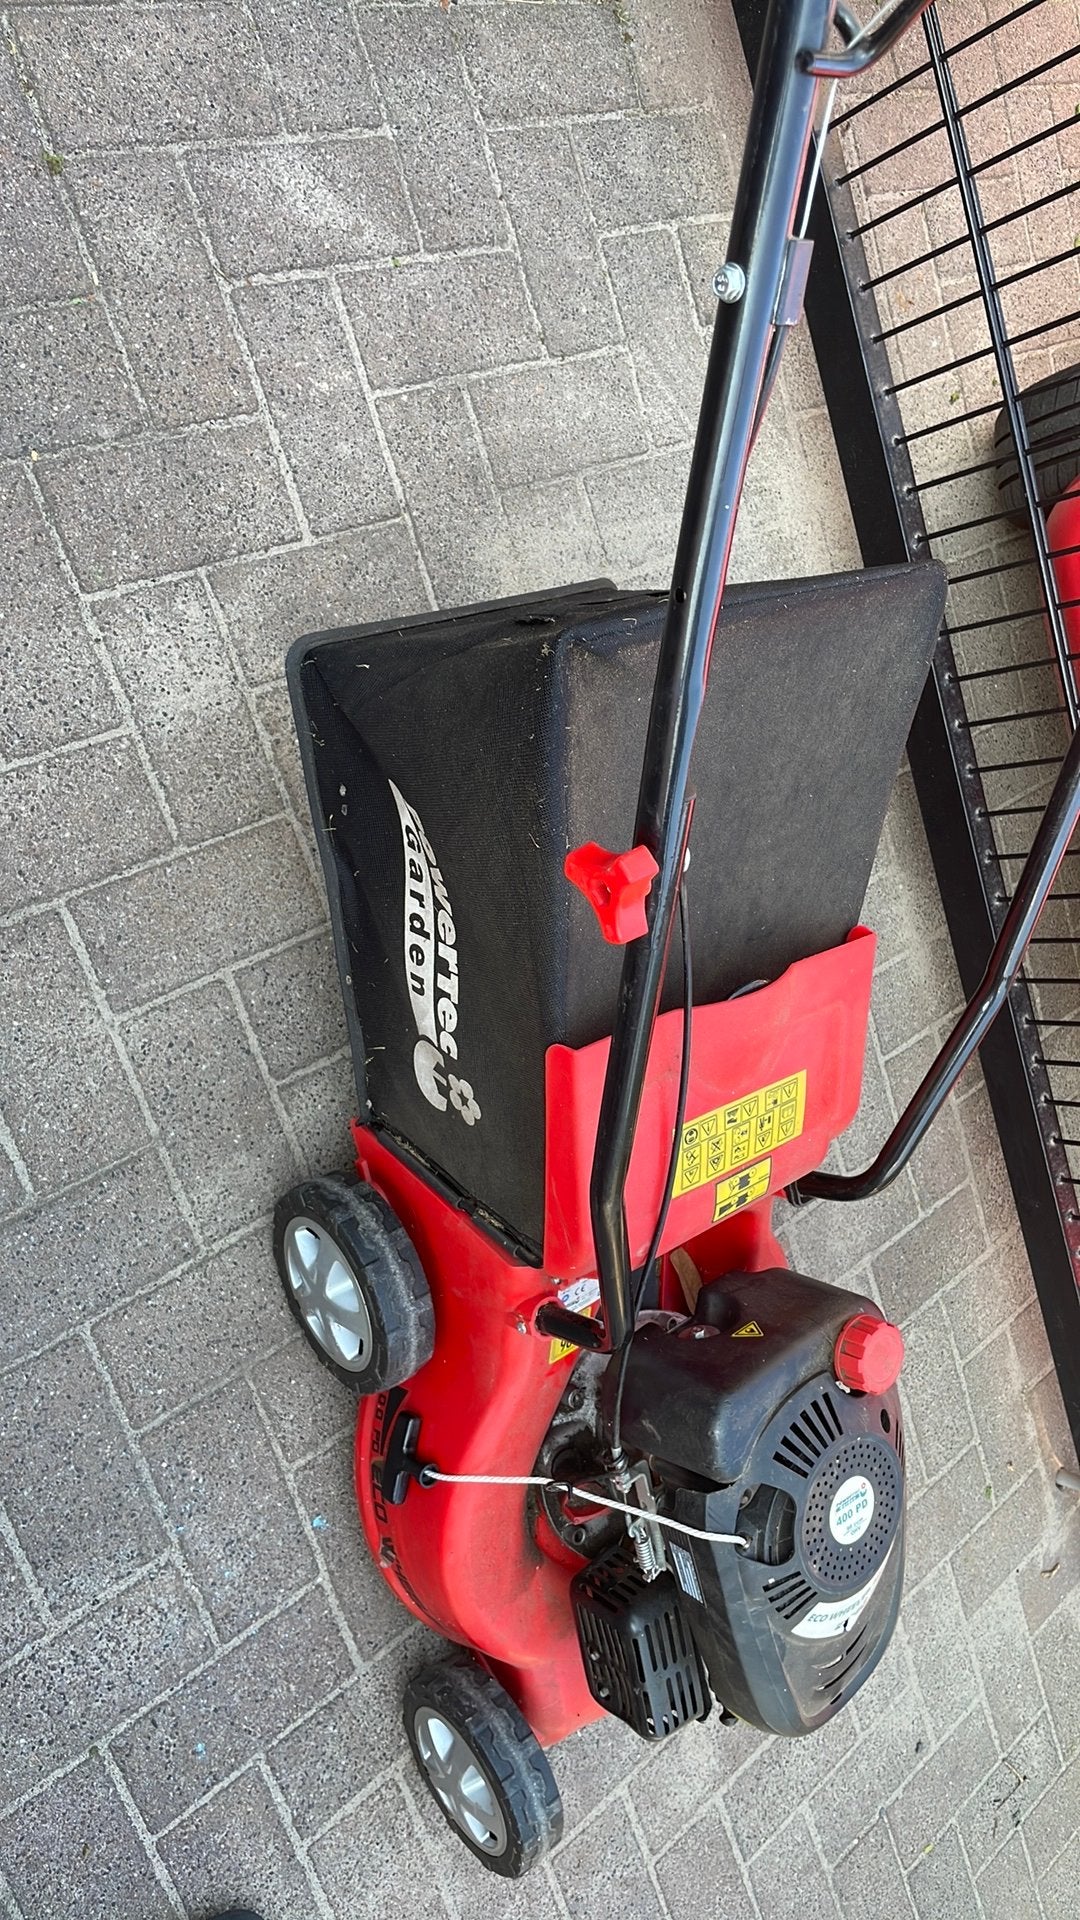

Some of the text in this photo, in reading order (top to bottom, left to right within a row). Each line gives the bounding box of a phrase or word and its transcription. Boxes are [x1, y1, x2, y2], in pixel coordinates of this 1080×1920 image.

[405, 824, 431, 997] Garden
[836, 1508, 854, 1526] 400
[855, 1498, 868, 1513] PD
[808, 1613, 829, 1623] ECO
